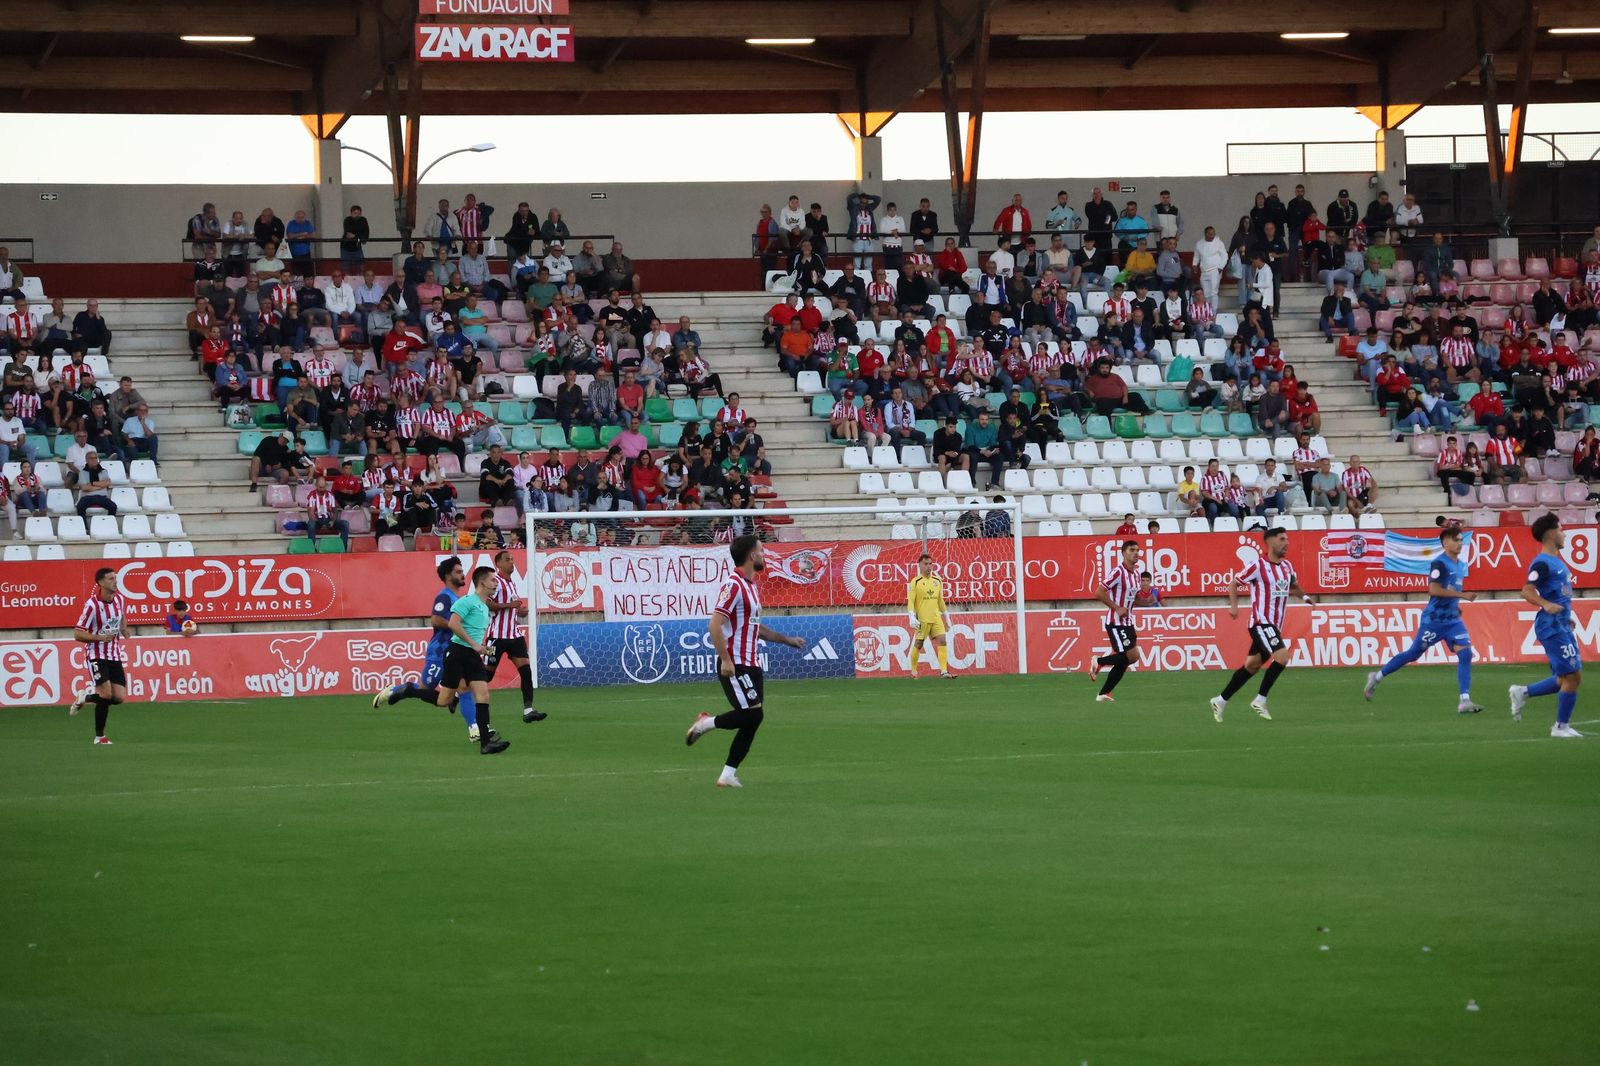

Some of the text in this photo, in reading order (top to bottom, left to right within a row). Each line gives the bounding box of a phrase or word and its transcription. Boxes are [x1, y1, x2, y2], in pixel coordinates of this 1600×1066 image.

[420, 27, 569, 58] ZAMORACF
[1571, 534, 1589, 564] 8
[610, 556, 731, 583] CASTAÑEDA
[968, 555, 1060, 580] ÓPTCO
[1, 582, 37, 594] Grupo
[1364, 576, 1429, 588] AYUNTAMI
[2, 594, 76, 608] Leomotor
[126, 600, 312, 614] MBUTDOS Y JAMONES
[614, 593, 713, 616] NO ES RIVAL
[1120, 629, 1127, 639] 5
[1263, 626, 1276, 638] 10
[1421, 630, 1437, 642] 22
[133, 645, 191, 667] Joven
[347, 639, 428, 661] Escu
[1091, 643, 1227, 671] ZMORA
[1560, 643, 1576, 659] 30
[428, 664, 441, 677] 21
[149, 680, 161, 701] y
[165, 671, 213, 695] León
[738, 674, 753, 689] 18
